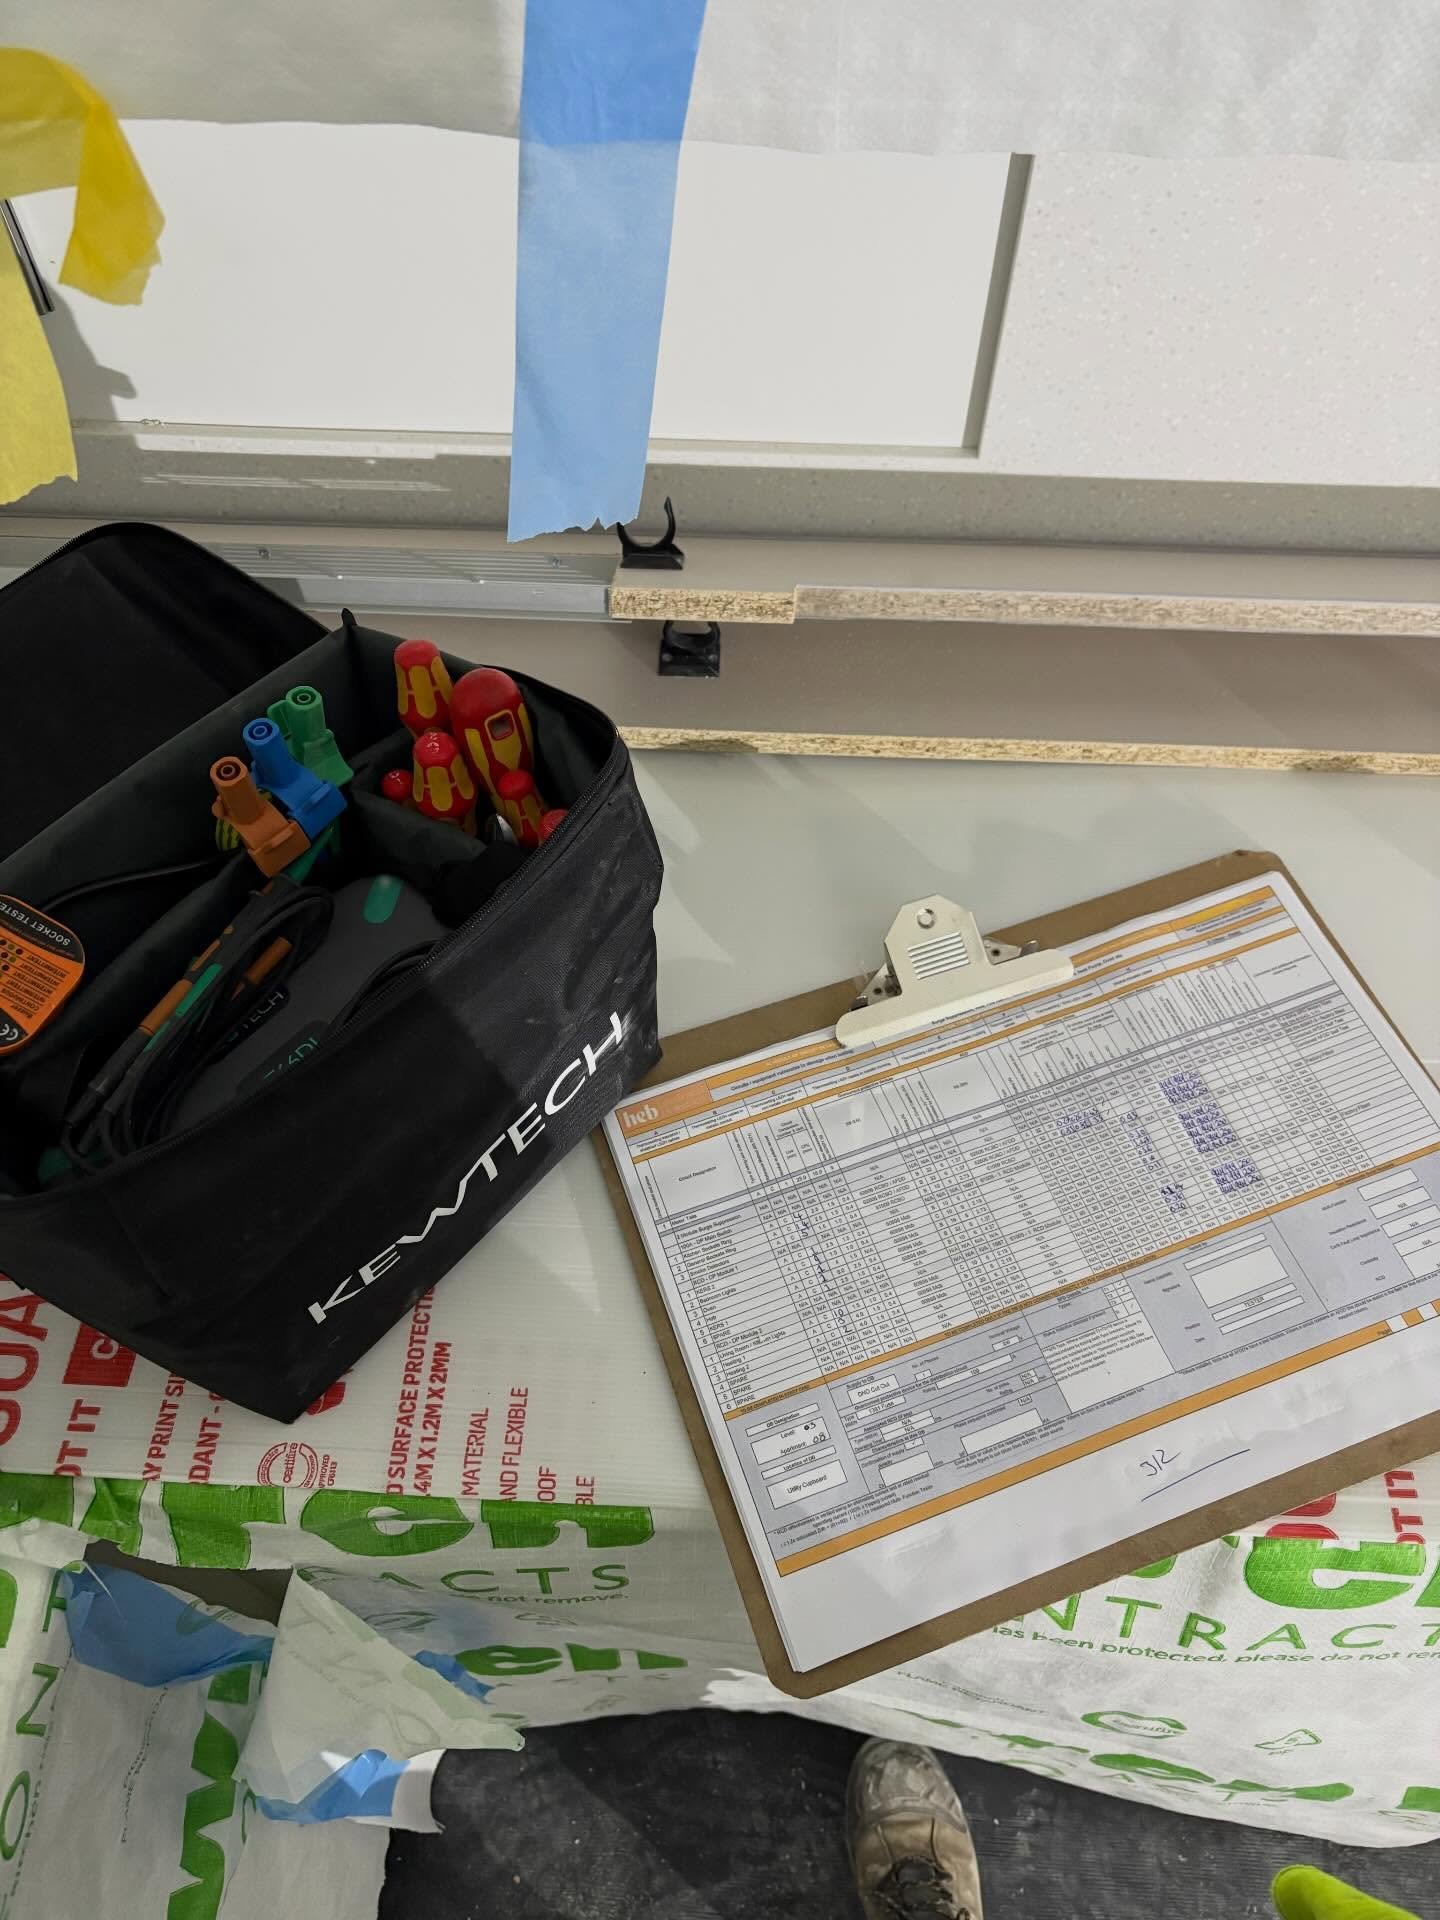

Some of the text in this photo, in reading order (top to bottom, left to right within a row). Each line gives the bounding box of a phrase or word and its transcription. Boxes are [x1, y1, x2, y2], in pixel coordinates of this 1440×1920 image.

[0, 901, 30, 925] TESTE
[31, 919, 71, 946] SOCKET
[621, 1102, 659, 1128] heb
[308, 1011, 630, 1324] KEWTECH
[720, 1237, 733, 1247] Ring
[712, 1329, 731, 1340] SPARE
[429, 1341, 452, 1386] 2MM
[729, 1374, 748, 1386] SPARE
[732, 1384, 752, 1395] SPARE
[426, 1387, 446, 1401] X
[736, 1394, 755, 1405] SPARE
[66, 1399, 102, 1432] IT
[420, 1404, 442, 1445] 1.2M
[502, 1387, 528, 1467] FLEXIBLE
[147, 1399, 180, 1460] PRINT
[388, 1389, 419, 1480] SURFACE
[188, 1417, 222, 1485] DANT
[421, 1447, 436, 1461] X
[461, 1407, 489, 1496] MATERIAL
[786, 1473, 828, 1495] Utility Cupboard
[1031, 1632, 1095, 1651] been
[1100, 1642, 1228, 1664] protected,
[1233, 1650, 1315, 1665] please
[1320, 1651, 1354, 1662] do
[1359, 1650, 1402, 1662] not
